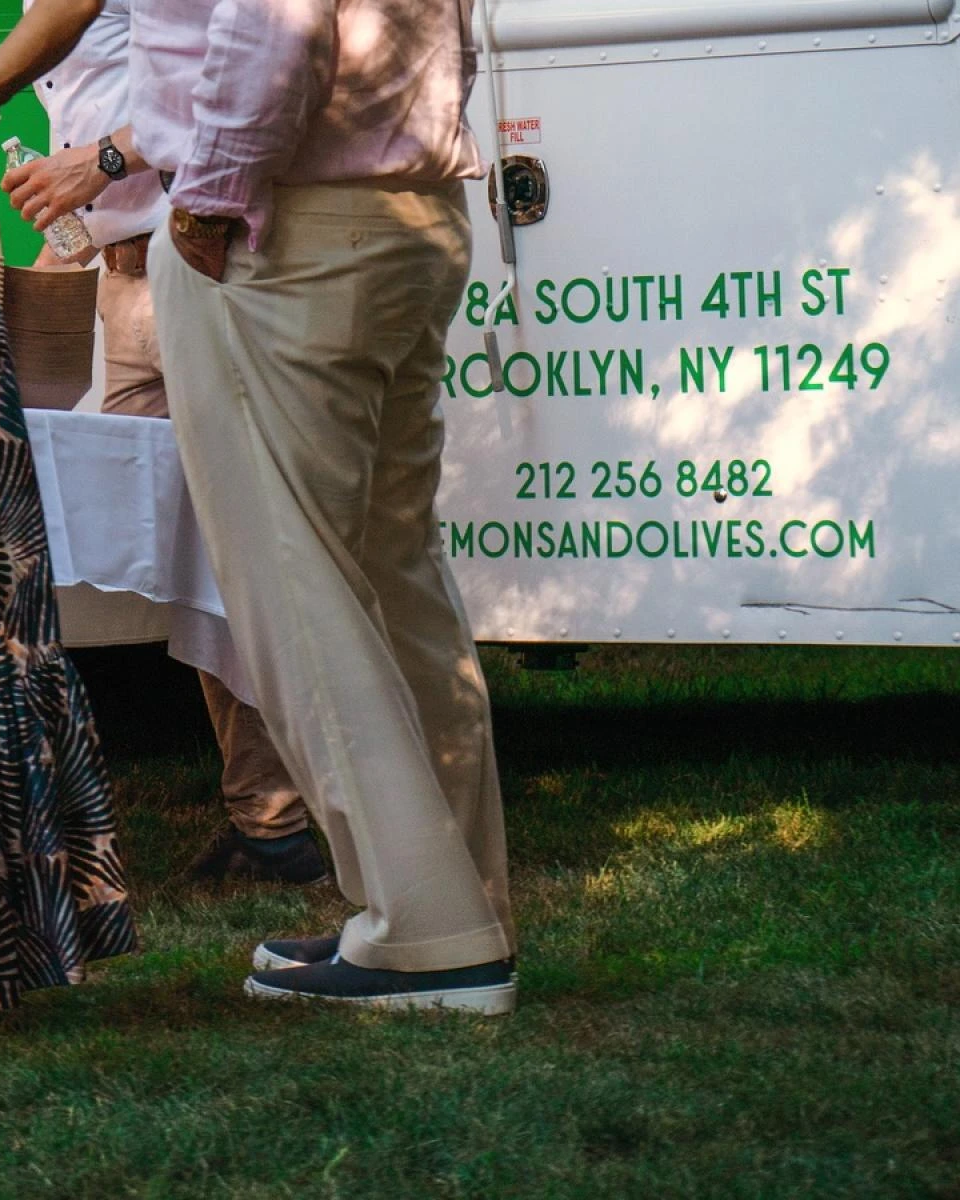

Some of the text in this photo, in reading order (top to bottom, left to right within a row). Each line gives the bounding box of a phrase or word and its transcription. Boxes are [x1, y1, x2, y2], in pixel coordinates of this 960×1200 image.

[510, 131, 524, 143] FILL
[516, 119, 540, 131] WATER
[449, 268, 851, 326] 8A SOUTH 4TH ST
[440, 342, 890, 400] ROOKLYN, NY 11249
[516, 459, 772, 499] 212 256 8482
[439, 519, 876, 558] MONSANDOLIVES.COM
